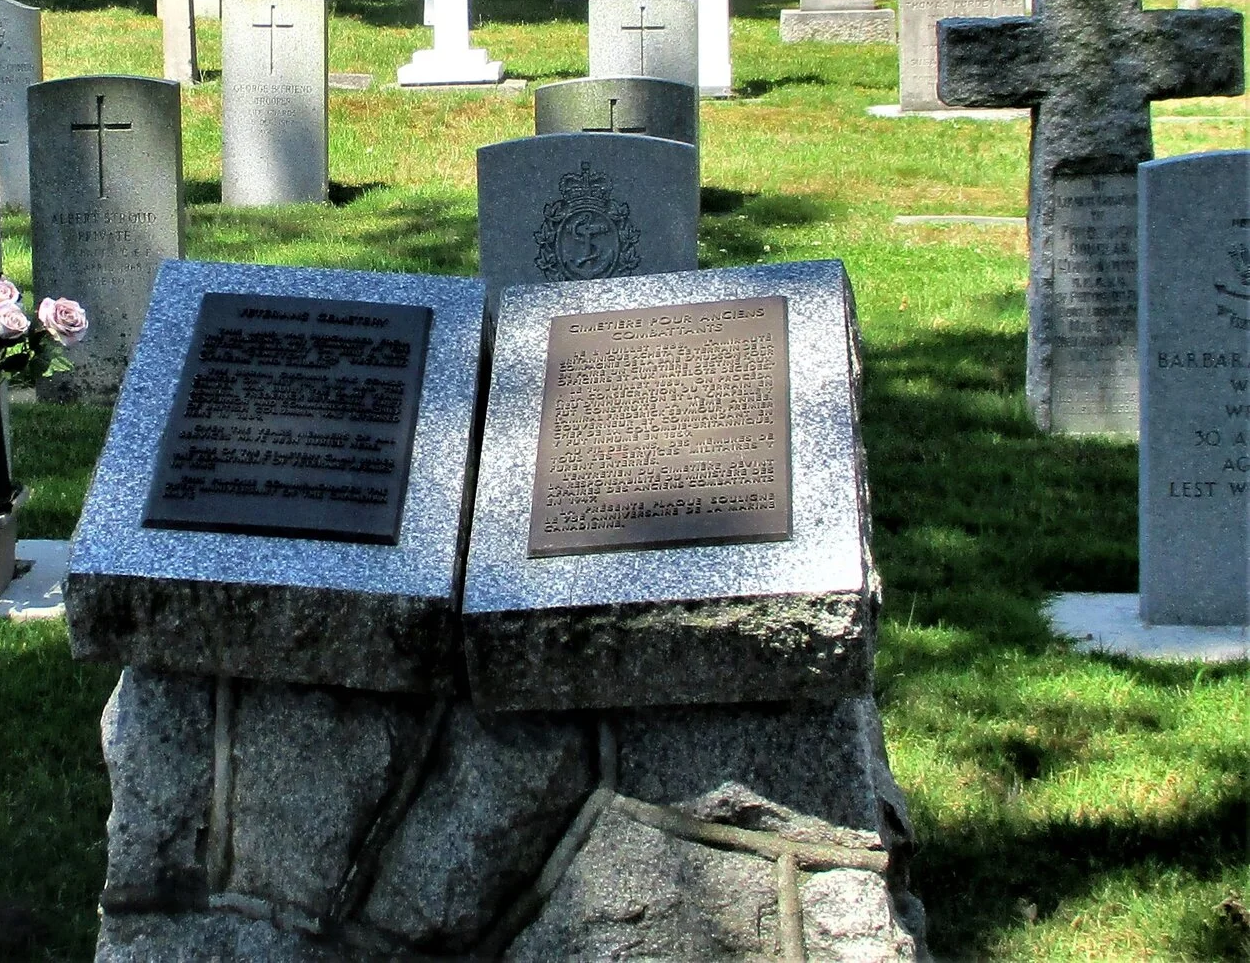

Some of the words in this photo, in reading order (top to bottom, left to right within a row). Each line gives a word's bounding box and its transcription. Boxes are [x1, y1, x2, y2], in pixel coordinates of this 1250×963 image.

[233, 84, 269, 93] GEORGE
[281, 84, 313, 94] FRIEND
[104, 212, 156, 224] STROUD
[78, 230, 131, 242] PRIVATE
[569, 316, 642, 332] CIMETIÈRE
[650, 314, 691, 326] POUR
[700, 308, 764, 322] ANCIENS
[611, 323, 722, 340] COMBATTANTS
[605, 345, 649, 354] JUILLET
[704, 333, 771, 347] L'AMIRAUTÉ
[558, 361, 619, 372] COMPAGNIE
[657, 356, 680, 364] BAIE
[684, 352, 740, 362] D'HUDSON
[743, 349, 773, 358] POUR
[559, 354, 629, 365] BRITANNIQUE
[632, 350, 674, 359] ACHETA
[693, 345, 739, 354] TERRAIN
[1157, 352, 1250, 370] BARBAR
[576, 369, 605, 378] FAIRE
[748, 356, 772, 364] AUX
[557, 376, 612, 386] OFFICIERS
[658, 368, 716, 378] MATELOTS
[605, 382, 649, 391] JUILLET
[718, 371, 772, 382] PROCÉDA
[702, 381, 751, 391] TERRAIN
[583, 395, 666, 407] D'INHUMATION
[705, 388, 760, 398] CHAPELLE
[554, 414, 602, 424] L'AMIRAL
[728, 401, 772, 411] PREMIER
[555, 409, 576, 417] FUT
[584, 403, 656, 415] CONSTRUITE
[553, 419, 633, 431] GOUVERNEUR
[660, 410, 750, 423] COMMANDANT
[553, 430, 582, 439] CHEF
[586, 429, 601, 437] DE
[605, 427, 620, 435] LA
[695, 436, 751, 446] MEMBRES
[1194, 430, 1221, 448] 30
[550, 455, 582, 464] TOUS
[621, 448, 679, 458] SERVICES
[688, 442, 757, 454] MILITAIRES
[549, 462, 593, 472] FURENT
[562, 469, 631, 480] L'ENTRETIEN
[729, 459, 774, 468] DEVINT
[547, 487, 600, 497] AFFAIRES
[606, 485, 628, 493] DES
[633, 481, 684, 491] ANCIENS
[688, 475, 774, 487] COMBATTANTS
[567, 475, 660, 488] RESPONSABILITÉ
[752, 467, 773, 475] DES
[1168, 482, 1218, 498] LEST
[559, 506, 575, 515] LA
[585, 502, 644, 513] PRÉSENTE
[653, 498, 701, 508] PLAQUE
[710, 493, 774, 505] SOULIGNE
[590, 508, 678, 521] ANNIVERSAIRE
[685, 506, 701, 514] DE
[706, 505, 722, 513] LA
[727, 501, 774, 512] MARINE
[544, 520, 626, 532] CANADIENNE.
